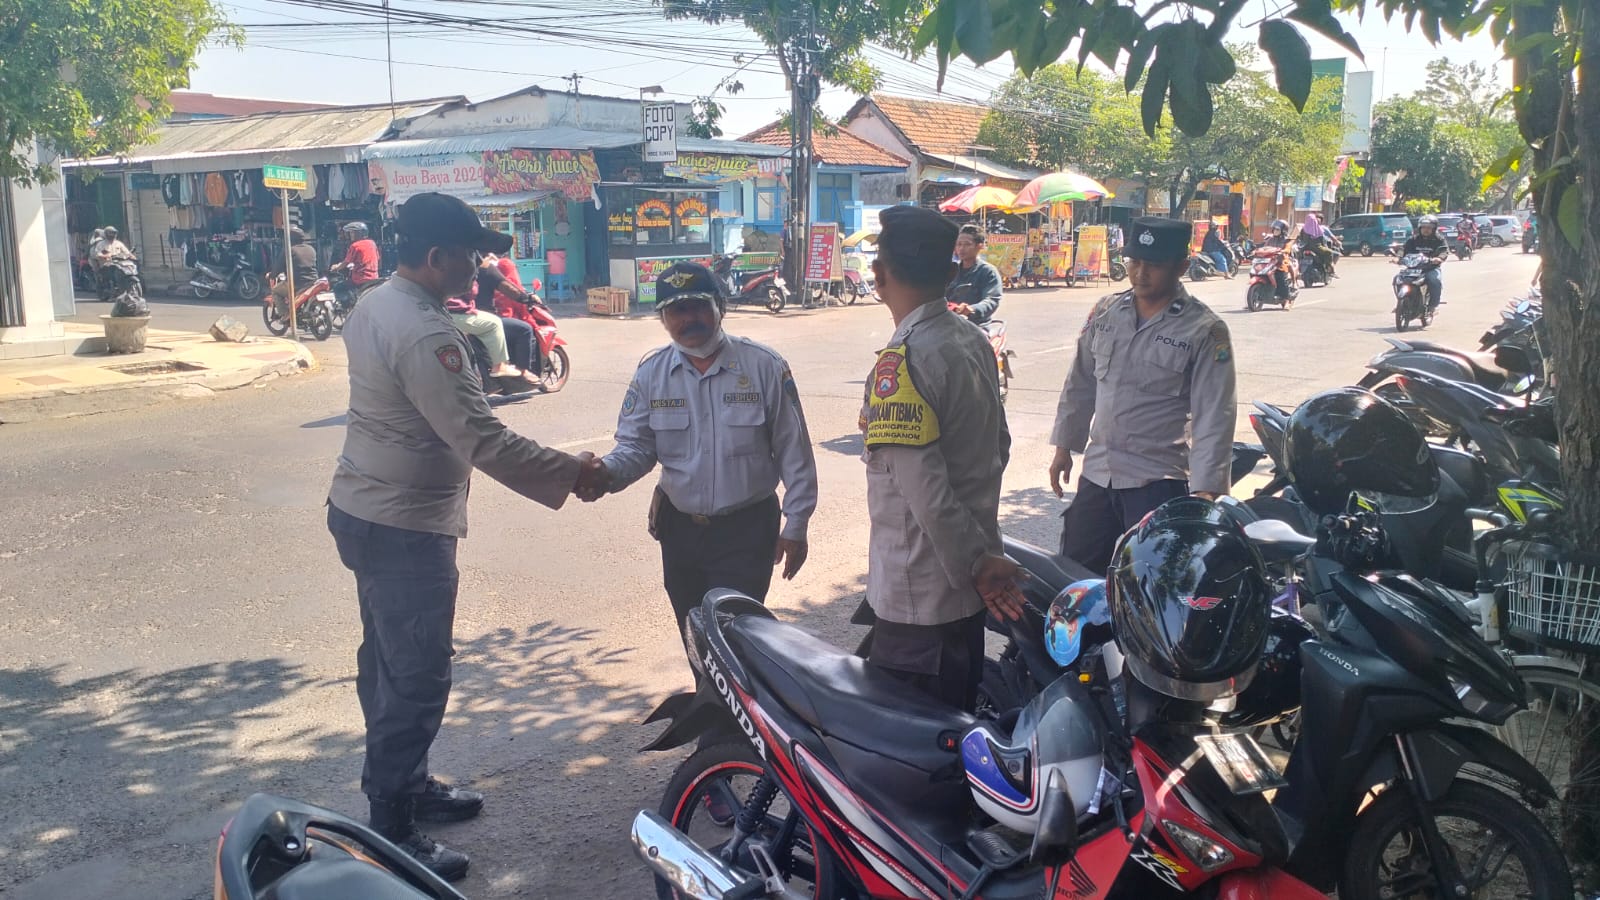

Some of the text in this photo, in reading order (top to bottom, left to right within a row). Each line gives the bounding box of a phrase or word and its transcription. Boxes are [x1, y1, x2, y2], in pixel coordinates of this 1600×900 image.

[645, 106, 674, 123] FOTO
[645, 125, 674, 142] COPY
[499, 153, 580, 179] Aneka Juice
[712, 156, 750, 172] Juice
[277, 169, 303, 181] SEMERU
[393, 170, 418, 188] Jaya
[420, 169, 450, 187] Baya
[1154, 335, 1191, 352] POLRI
[650, 399, 685, 409] MUSTAJI
[1319, 647, 1359, 676] HONDA
[704, 649, 767, 761] HONDA
